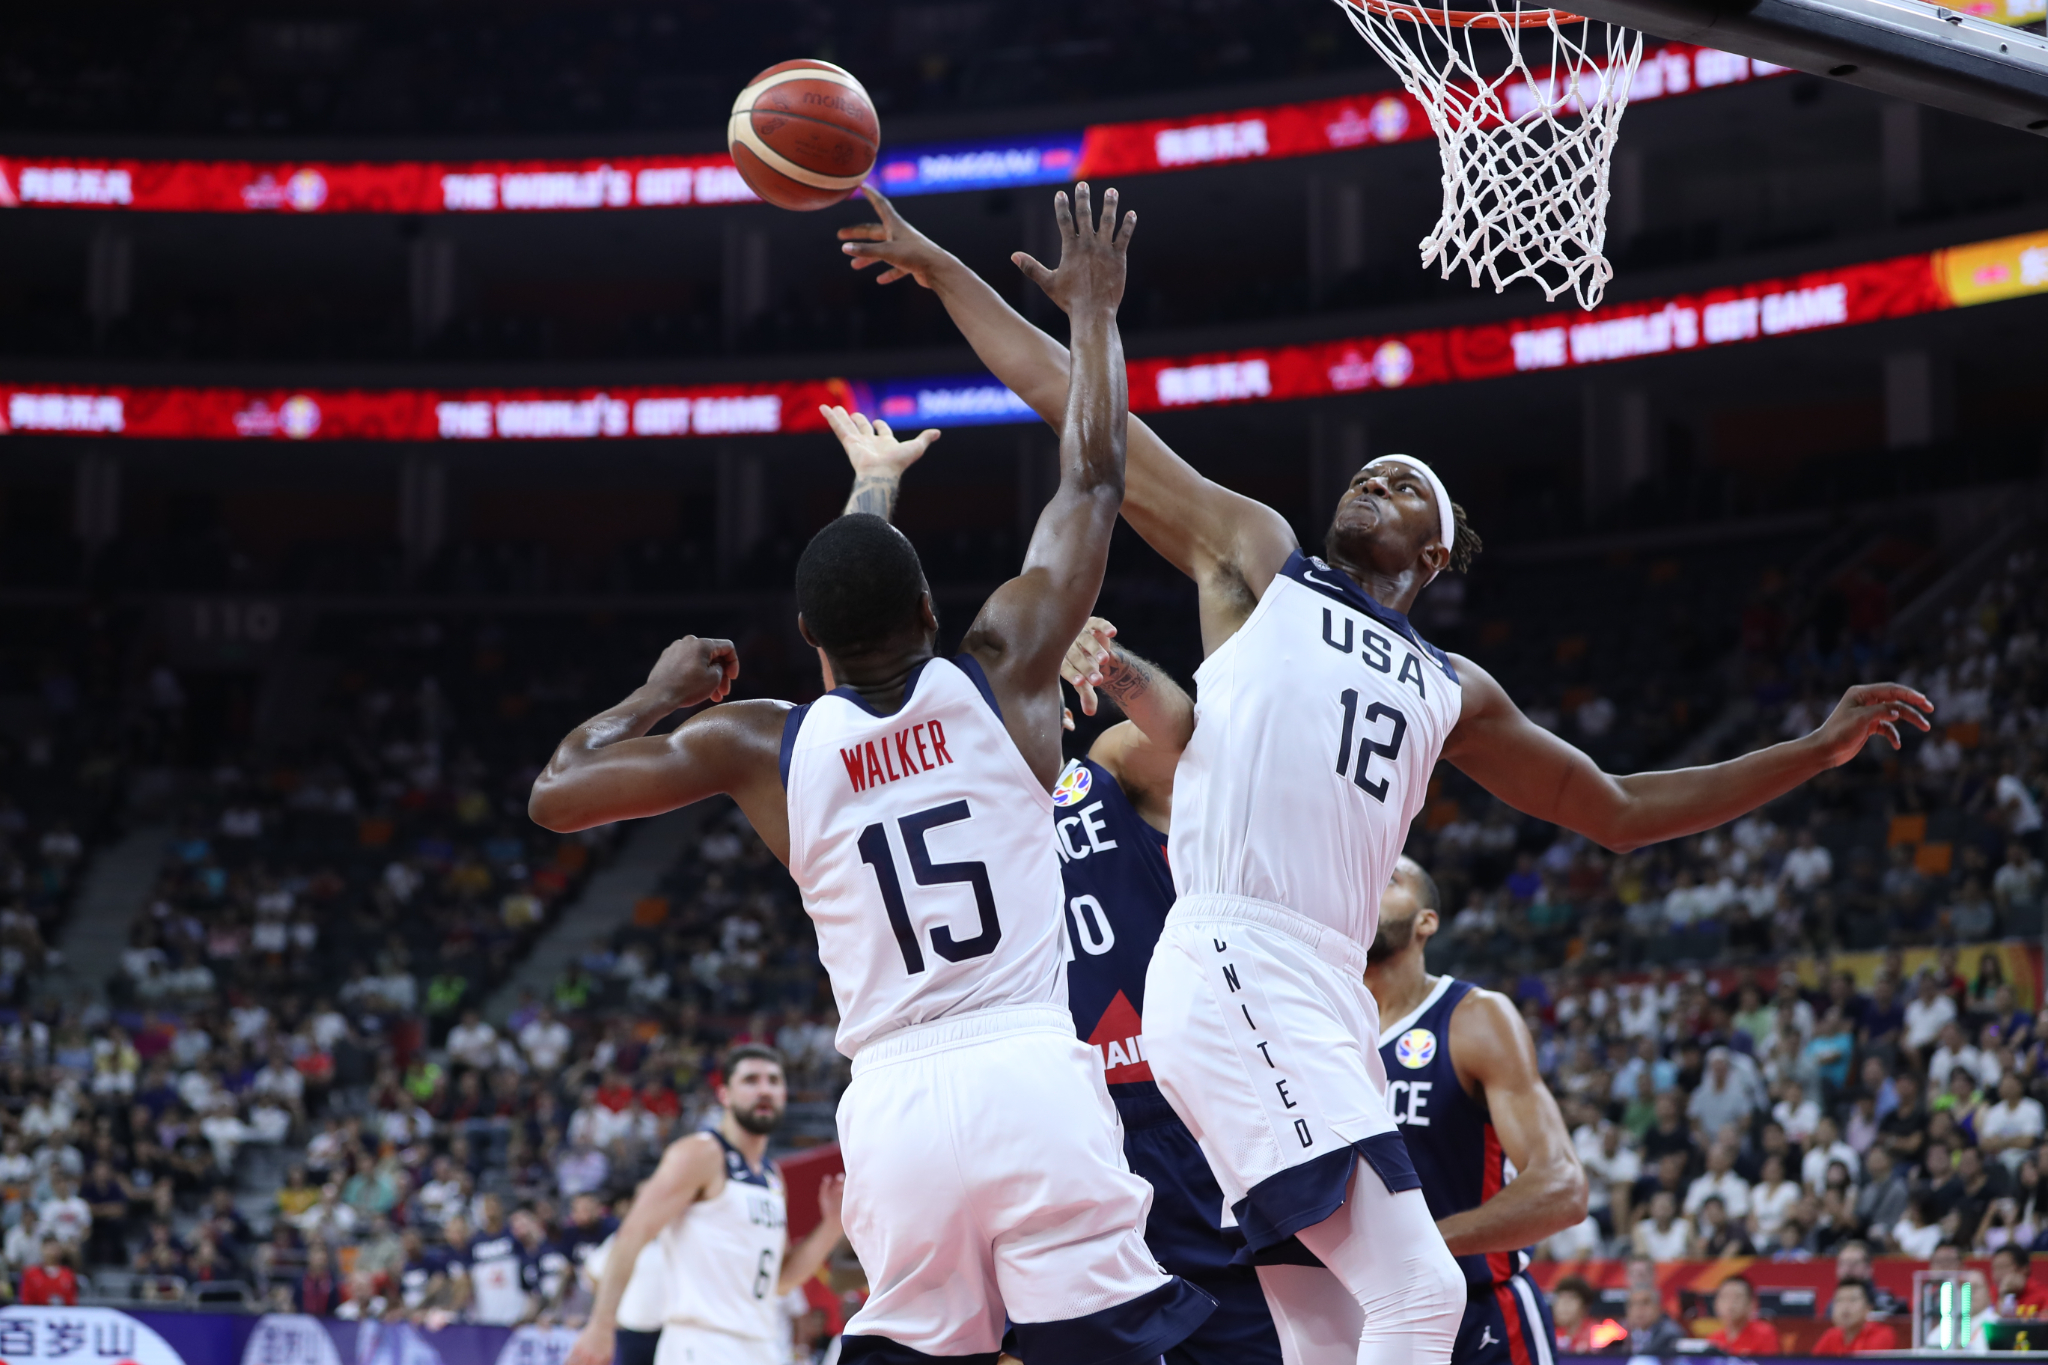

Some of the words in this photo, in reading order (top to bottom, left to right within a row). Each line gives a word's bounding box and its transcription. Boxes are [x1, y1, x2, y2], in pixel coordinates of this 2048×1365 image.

[802, 92, 863, 120] molten
[1322, 607, 1426, 700] USA
[840, 719, 953, 793] WALKER
[1336, 688, 1407, 804] 12
[857, 799, 1002, 976] 15
[753, 1248, 774, 1300] 6
[0, 1318, 135, 1357] 百岁山
